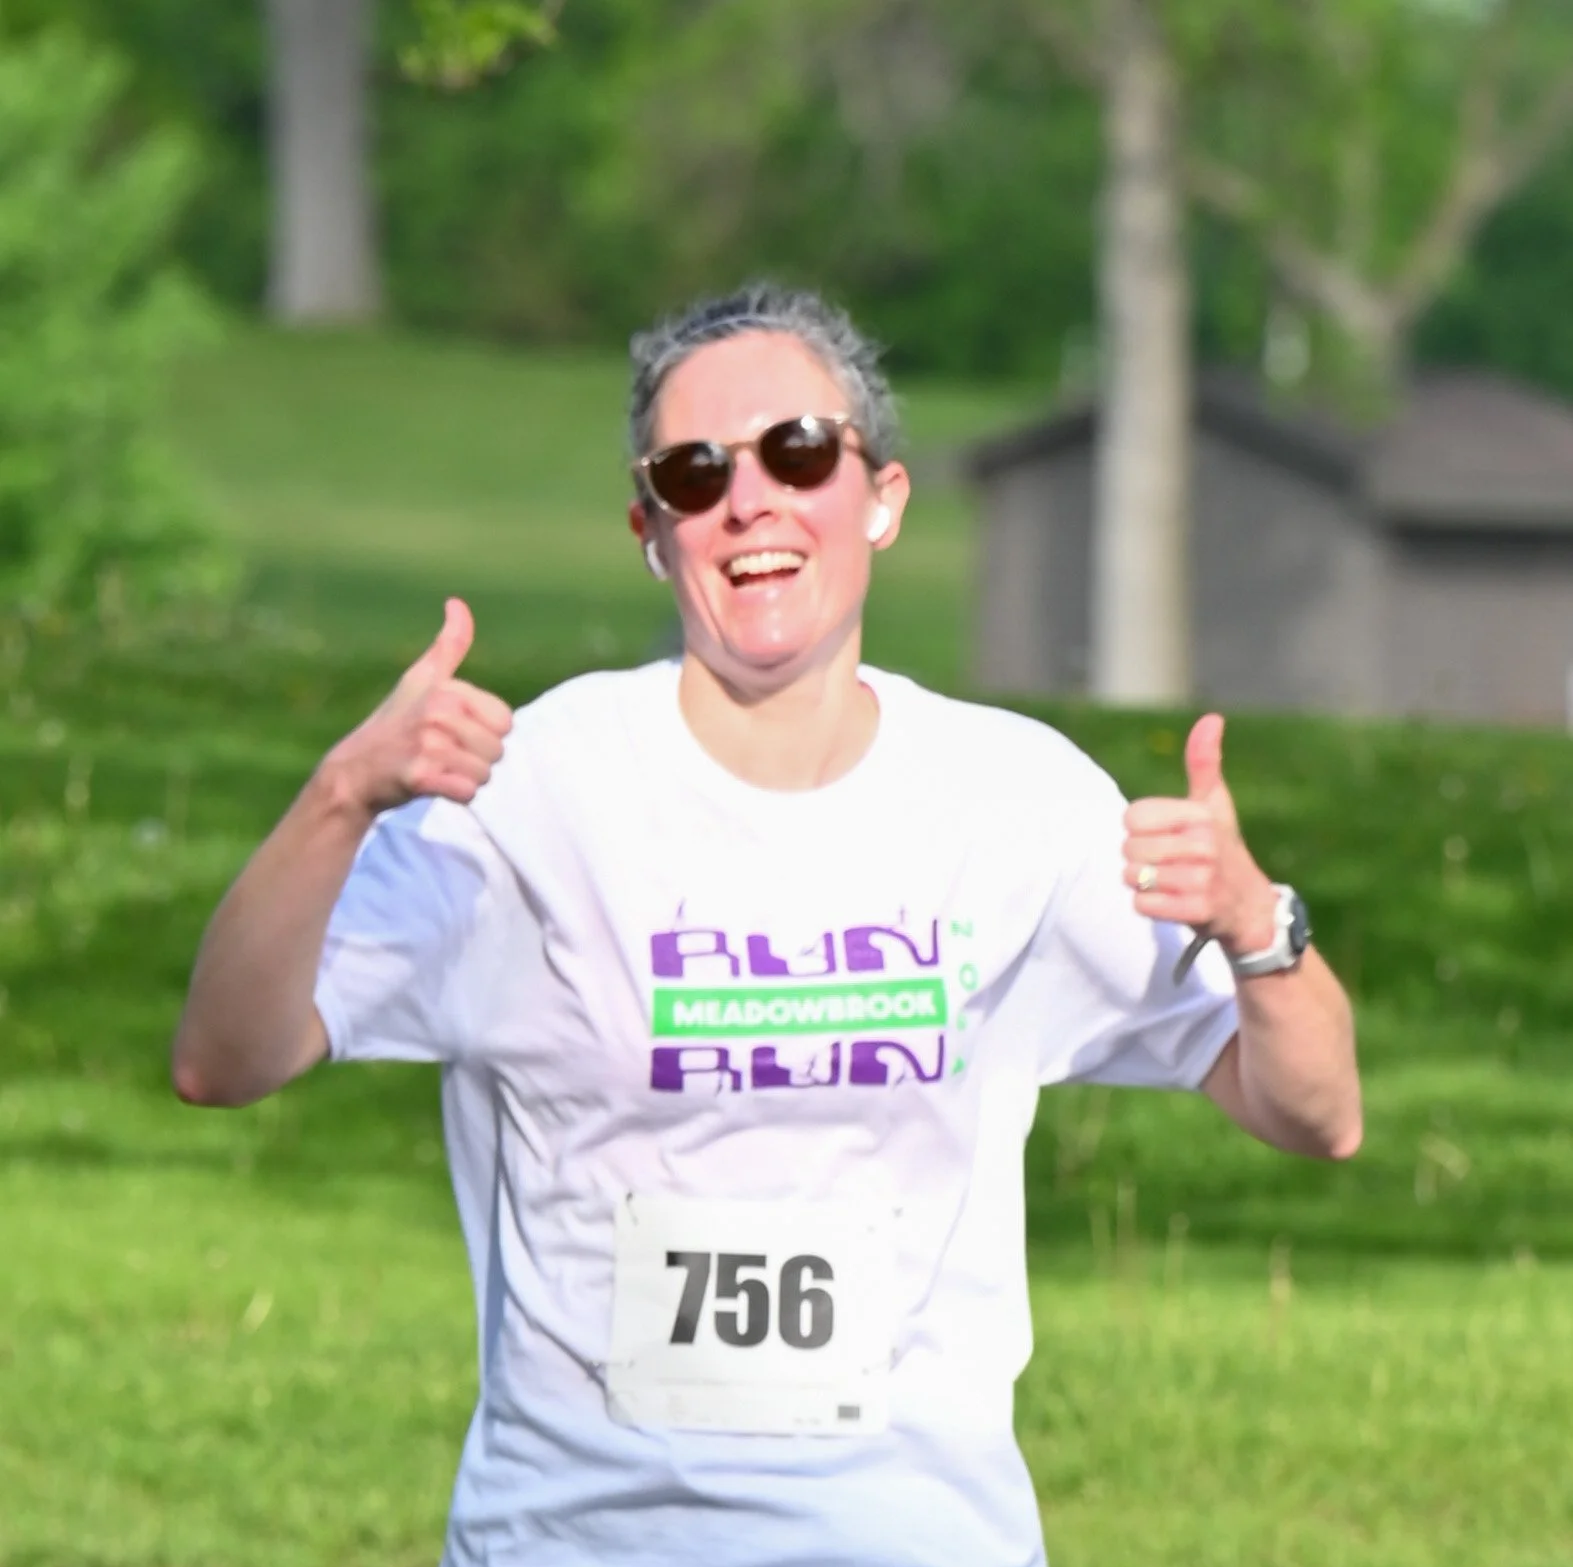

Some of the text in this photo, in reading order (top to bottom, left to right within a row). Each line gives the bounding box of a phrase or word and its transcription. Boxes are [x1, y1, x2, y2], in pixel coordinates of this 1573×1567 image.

[650, 917, 940, 978] RUN
[672, 989, 938, 1030] MEADOWBROOK
[650, 1034, 945, 1095] RUN
[665, 1249, 835, 1351] 756
